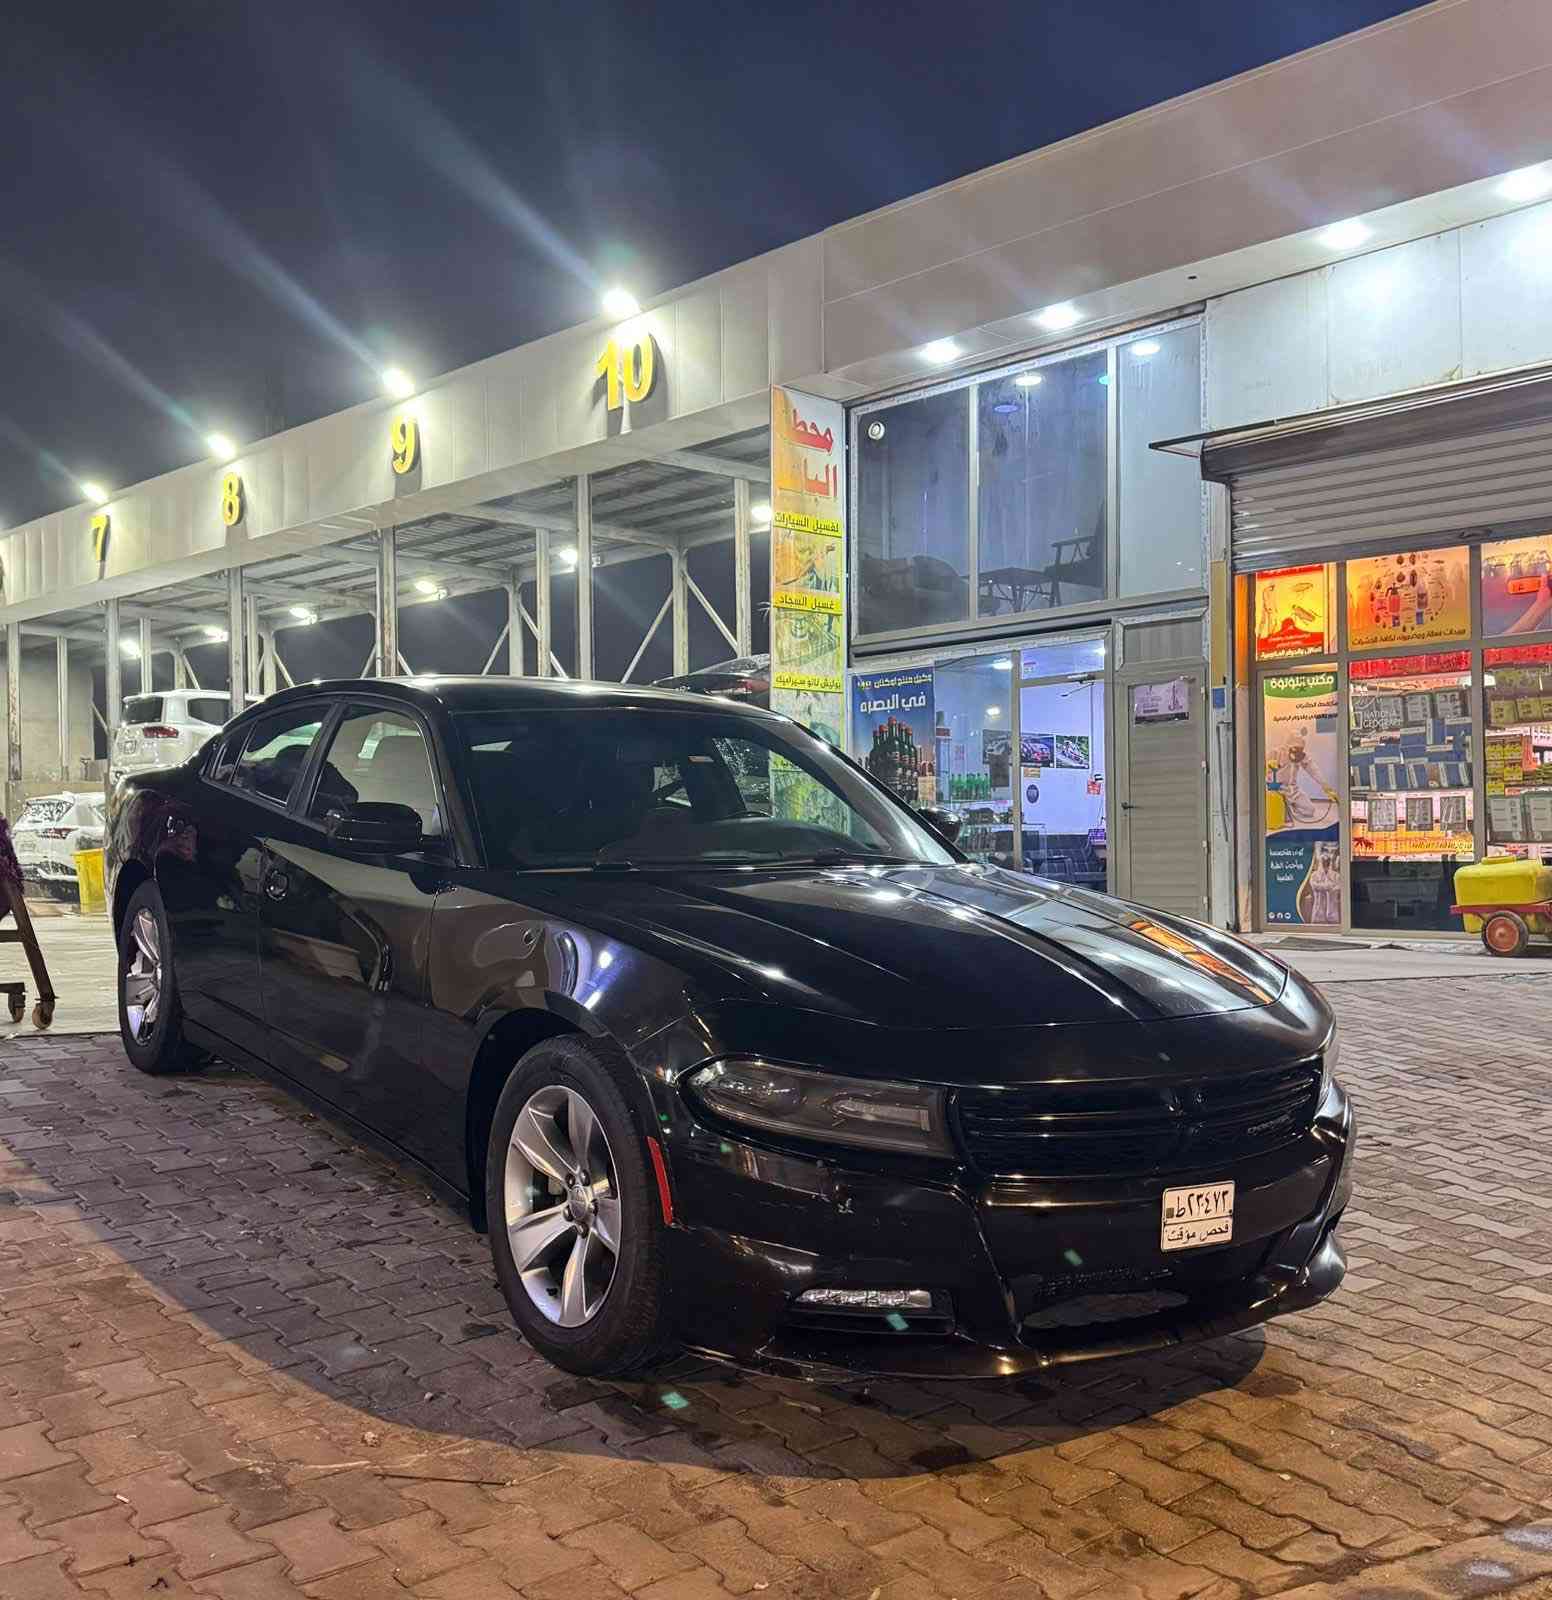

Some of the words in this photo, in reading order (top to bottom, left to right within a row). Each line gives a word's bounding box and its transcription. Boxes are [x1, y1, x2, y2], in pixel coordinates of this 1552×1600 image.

[596, 331, 654, 411] 10
[391, 416, 415, 474] 9
[223, 472, 242, 525] 8
[91, 514, 108, 561] 7
[901, 691, 926, 712] في
[1199, 1220, 1229, 1242] فحص
